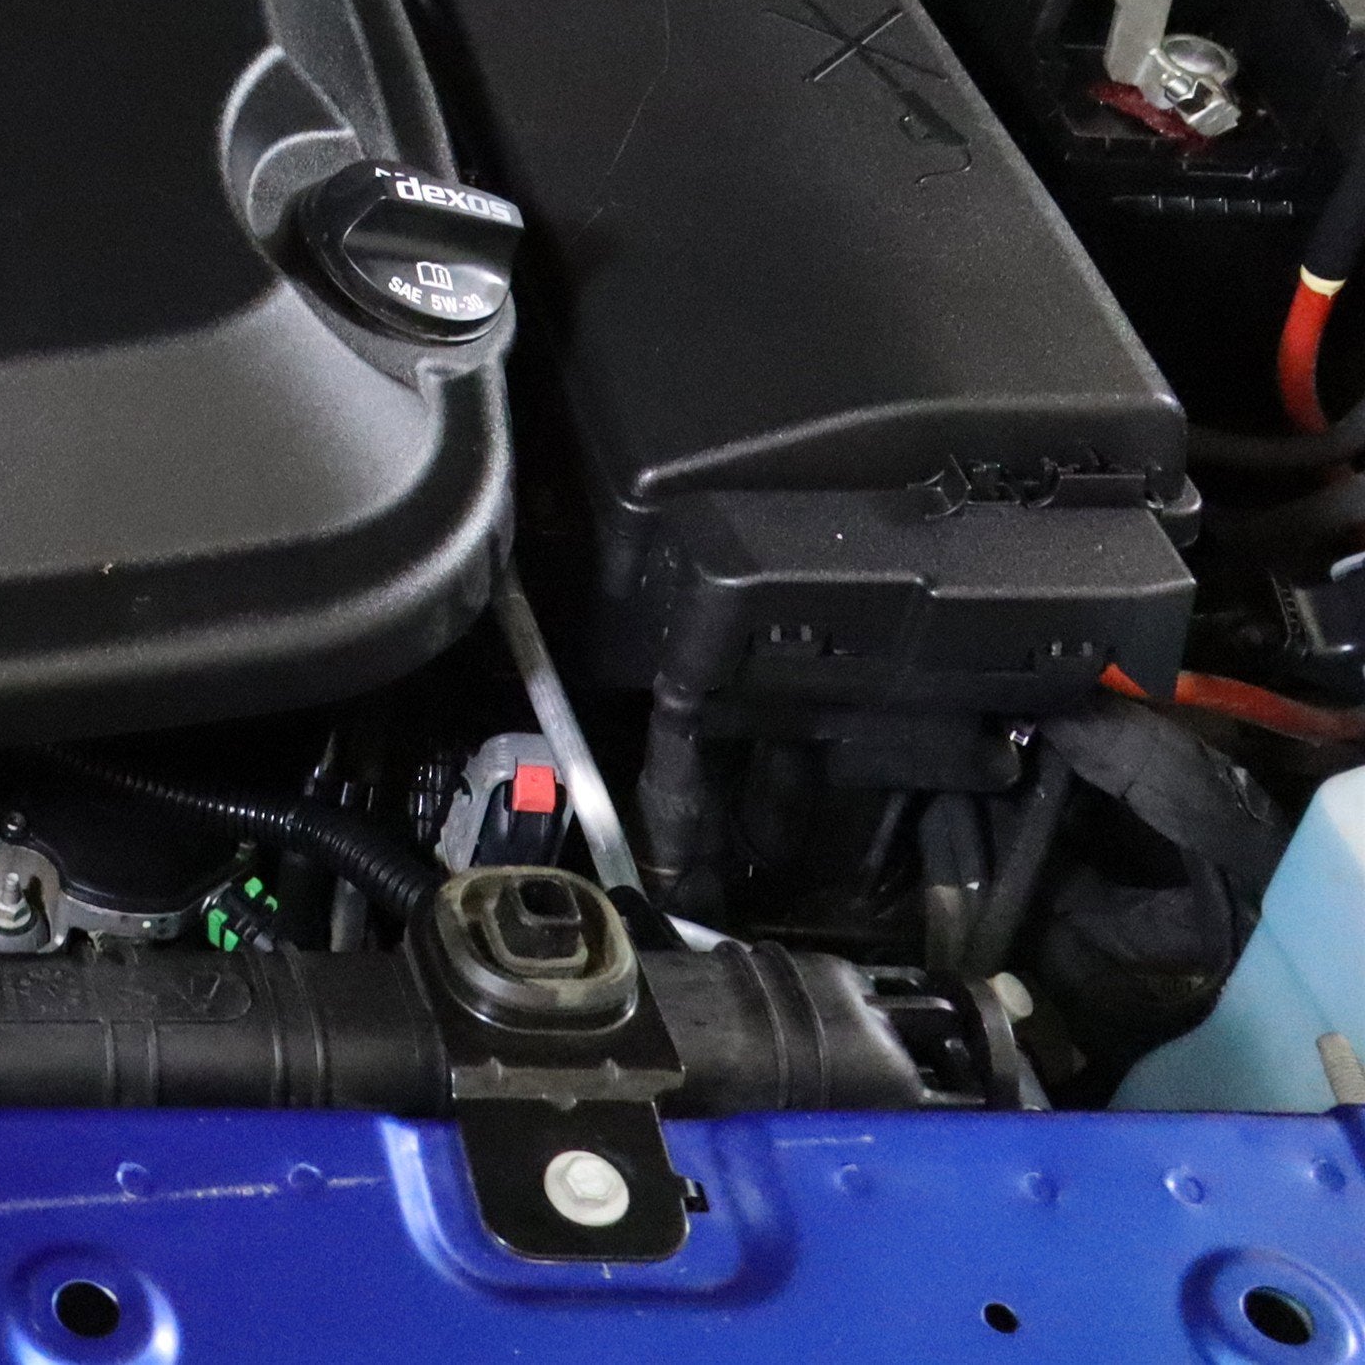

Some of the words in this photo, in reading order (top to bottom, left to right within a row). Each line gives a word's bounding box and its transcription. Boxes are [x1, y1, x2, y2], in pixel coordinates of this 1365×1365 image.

[395, 176, 511, 223] dexos
[388, 276, 423, 305] SAE
[431, 292, 485, 314] 5W-30
